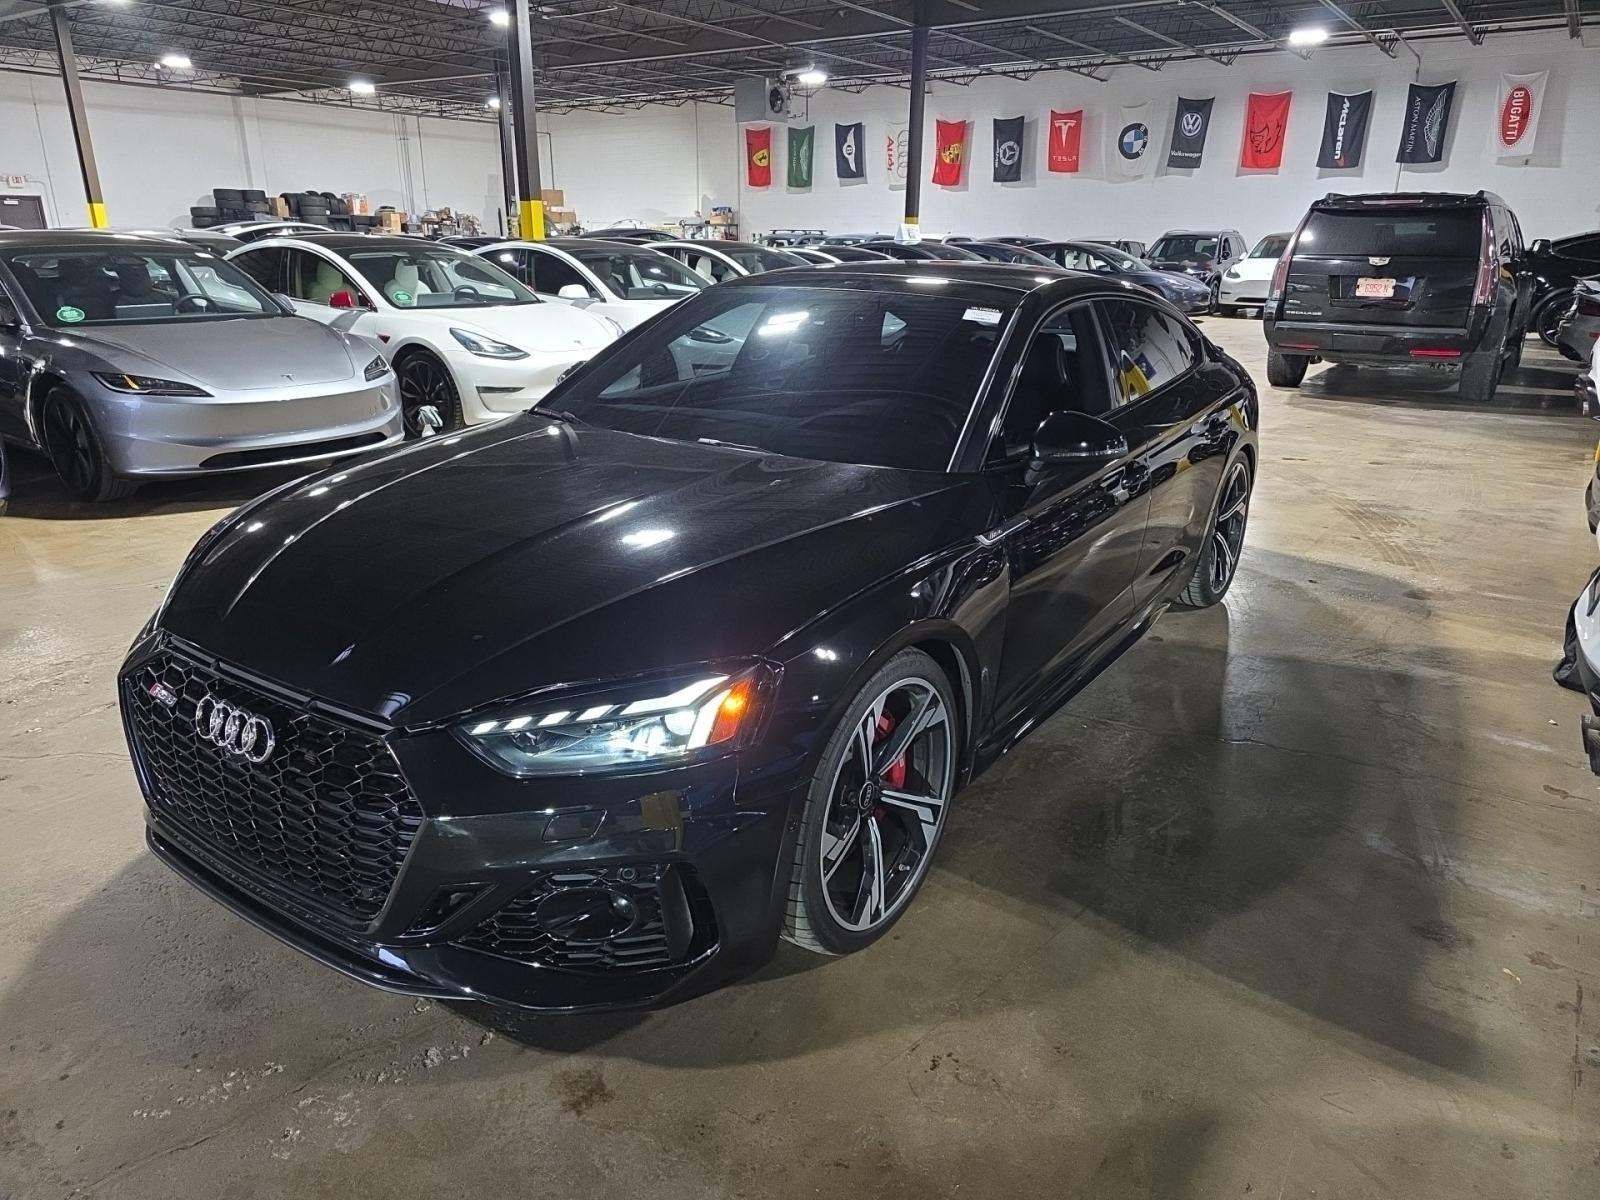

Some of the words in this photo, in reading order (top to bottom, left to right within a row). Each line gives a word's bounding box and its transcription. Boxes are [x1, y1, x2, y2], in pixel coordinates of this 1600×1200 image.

[1411, 96, 1422, 122] ASTON
[1505, 90, 1525, 140] BUGATTI
[1405, 123, 1418, 153] MARTIN
